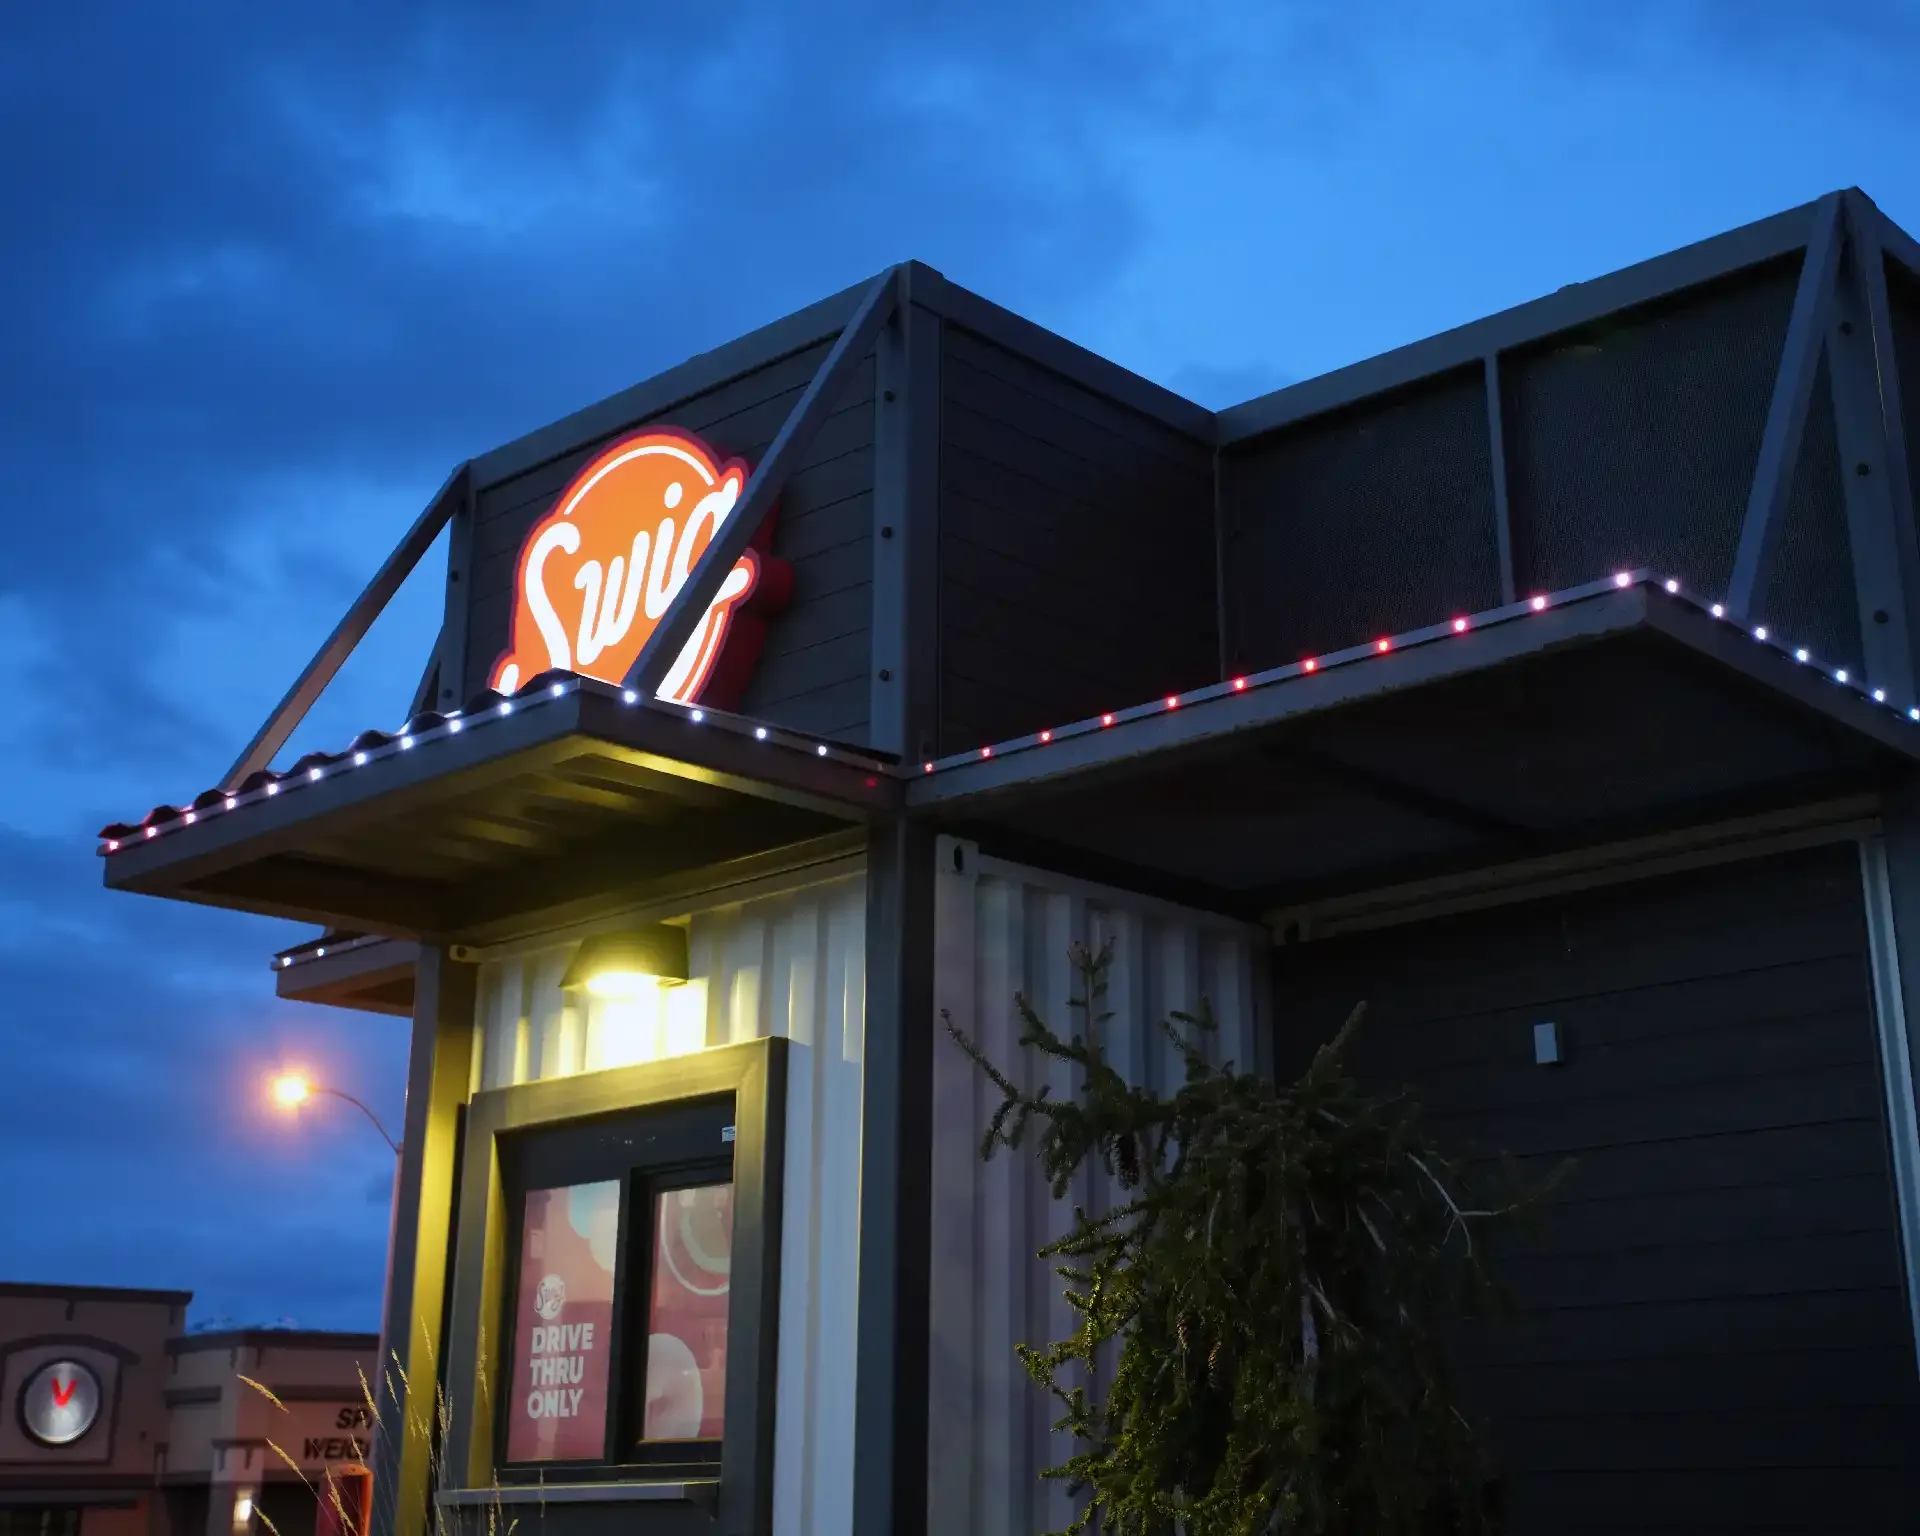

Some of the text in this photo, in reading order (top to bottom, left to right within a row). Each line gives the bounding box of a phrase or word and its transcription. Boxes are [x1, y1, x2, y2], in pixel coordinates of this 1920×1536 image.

[531, 1323, 593, 1353] DRIVE
[530, 1356, 584, 1386] THRU
[527, 1389, 584, 1419] ONLY
[304, 1437, 371, 1460] WEIG
